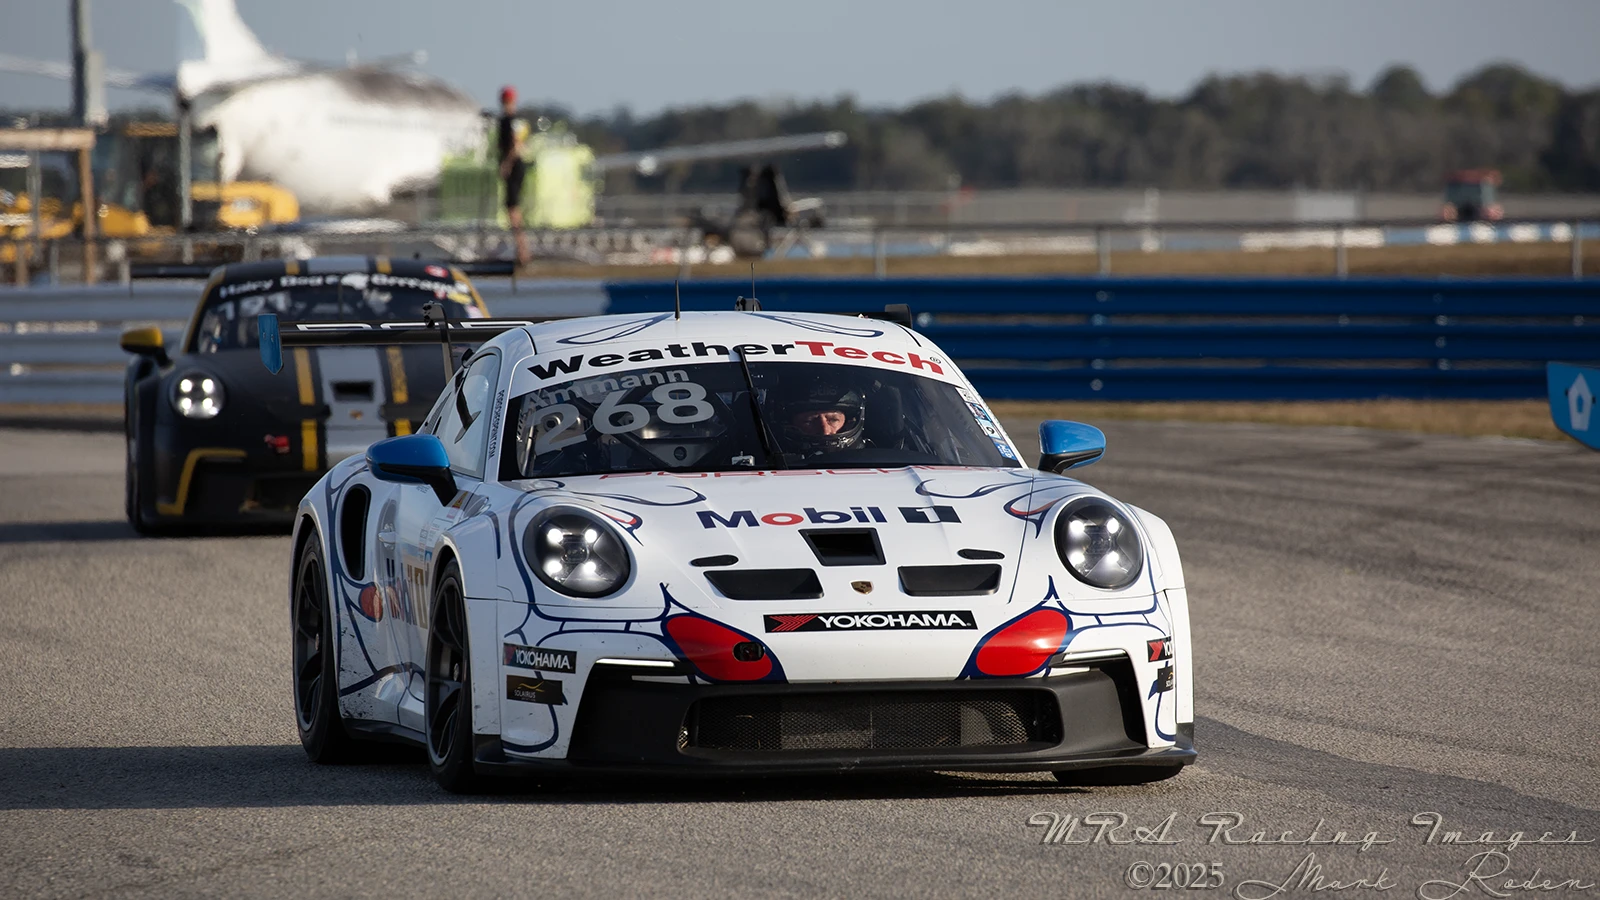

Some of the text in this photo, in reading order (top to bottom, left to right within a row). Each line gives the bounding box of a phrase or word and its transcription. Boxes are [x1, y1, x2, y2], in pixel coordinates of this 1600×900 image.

[527, 340, 944, 380] WeatherTech
[522, 369, 690, 413] Ammann
[527, 381, 715, 456] 268
[696, 506, 888, 529] Mobil
[818, 613, 967, 629] YOKOHAMA
[515, 649, 571, 670] YOKOHAMA
